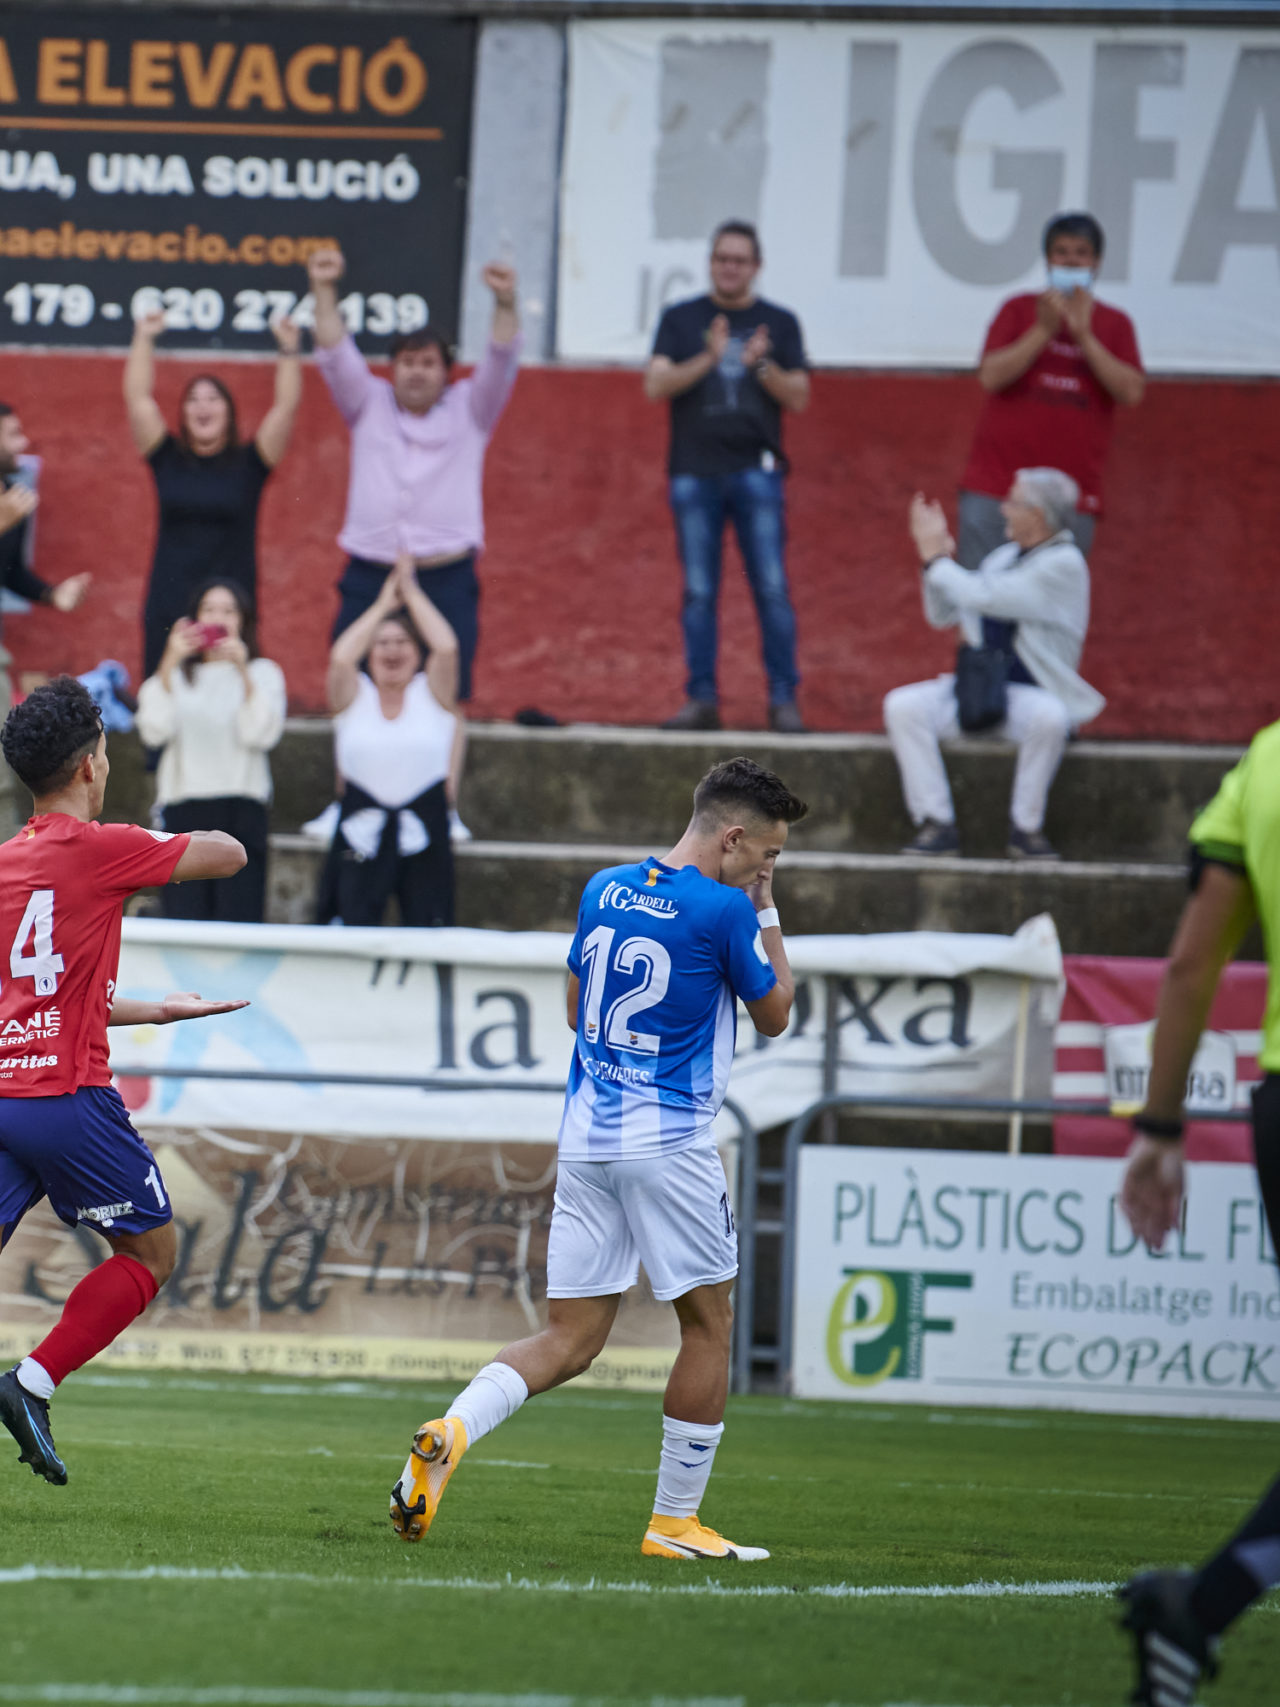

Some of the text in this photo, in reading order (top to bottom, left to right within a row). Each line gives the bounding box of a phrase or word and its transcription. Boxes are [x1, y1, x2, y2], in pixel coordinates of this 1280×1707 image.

[37, 37, 427, 116] ELEVACIÓ
[86, 152, 195, 196] UNA
[201, 152, 421, 202] SOLUCIÓ
[3, 281, 95, 327] 179
[337, 291, 430, 336] 139
[581, 924, 672, 1057] 12
[833, 1166, 1086, 1256] PLÀSTICS
[1011, 1272, 1213, 1326] Embalatge
